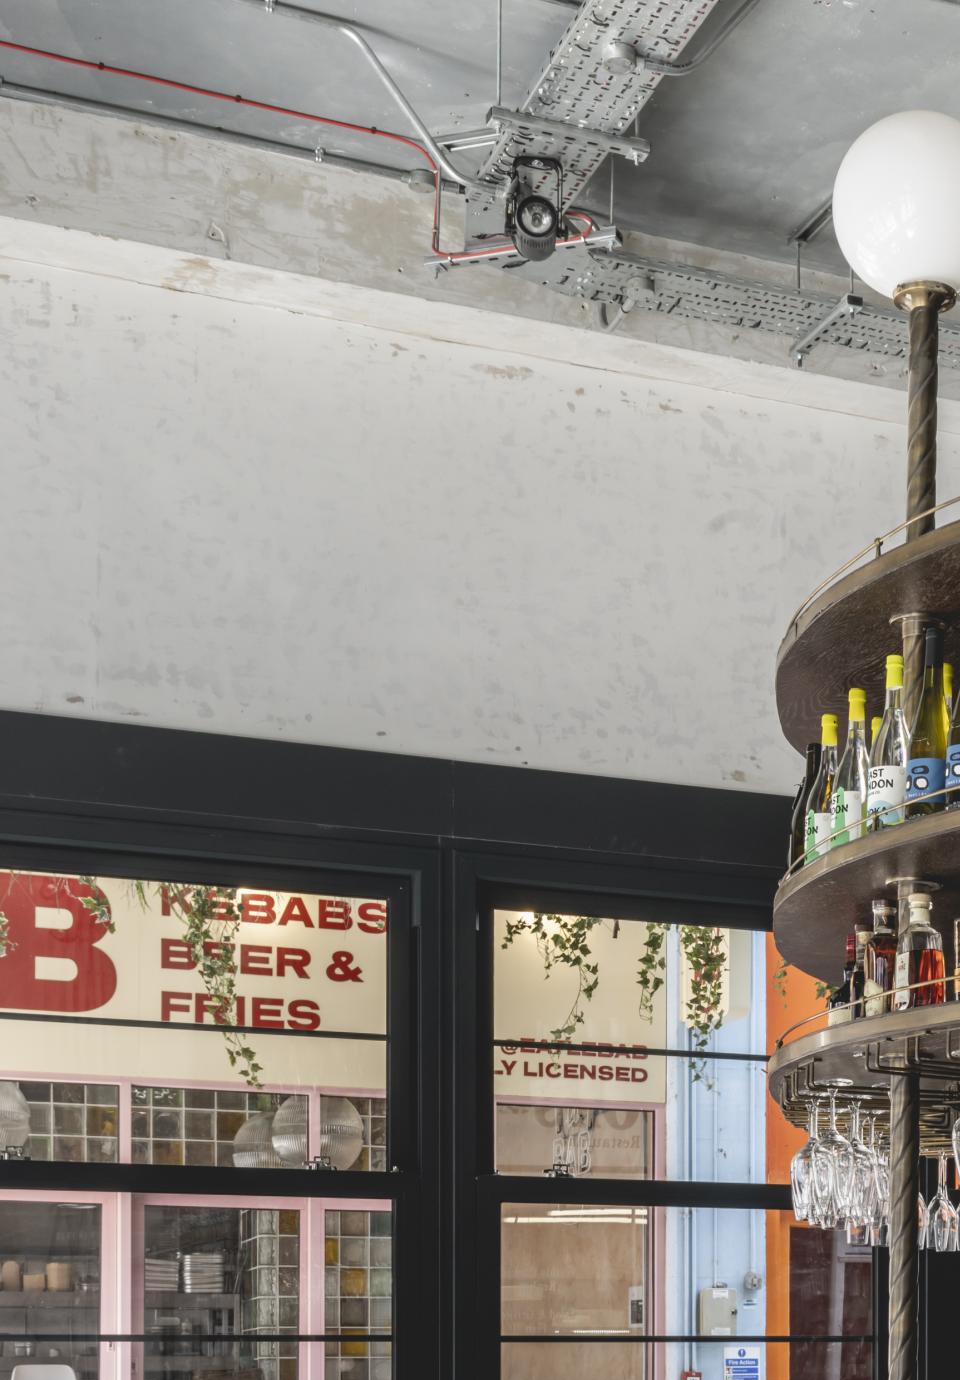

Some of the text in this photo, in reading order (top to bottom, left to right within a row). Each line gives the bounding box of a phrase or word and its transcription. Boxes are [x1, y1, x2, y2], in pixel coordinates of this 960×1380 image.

[161, 885, 387, 935] KEBABS
[161, 938, 364, 983] BEER &
[161, 990, 322, 1032] FRIES
[523, 1060, 649, 1083] LICENSED
